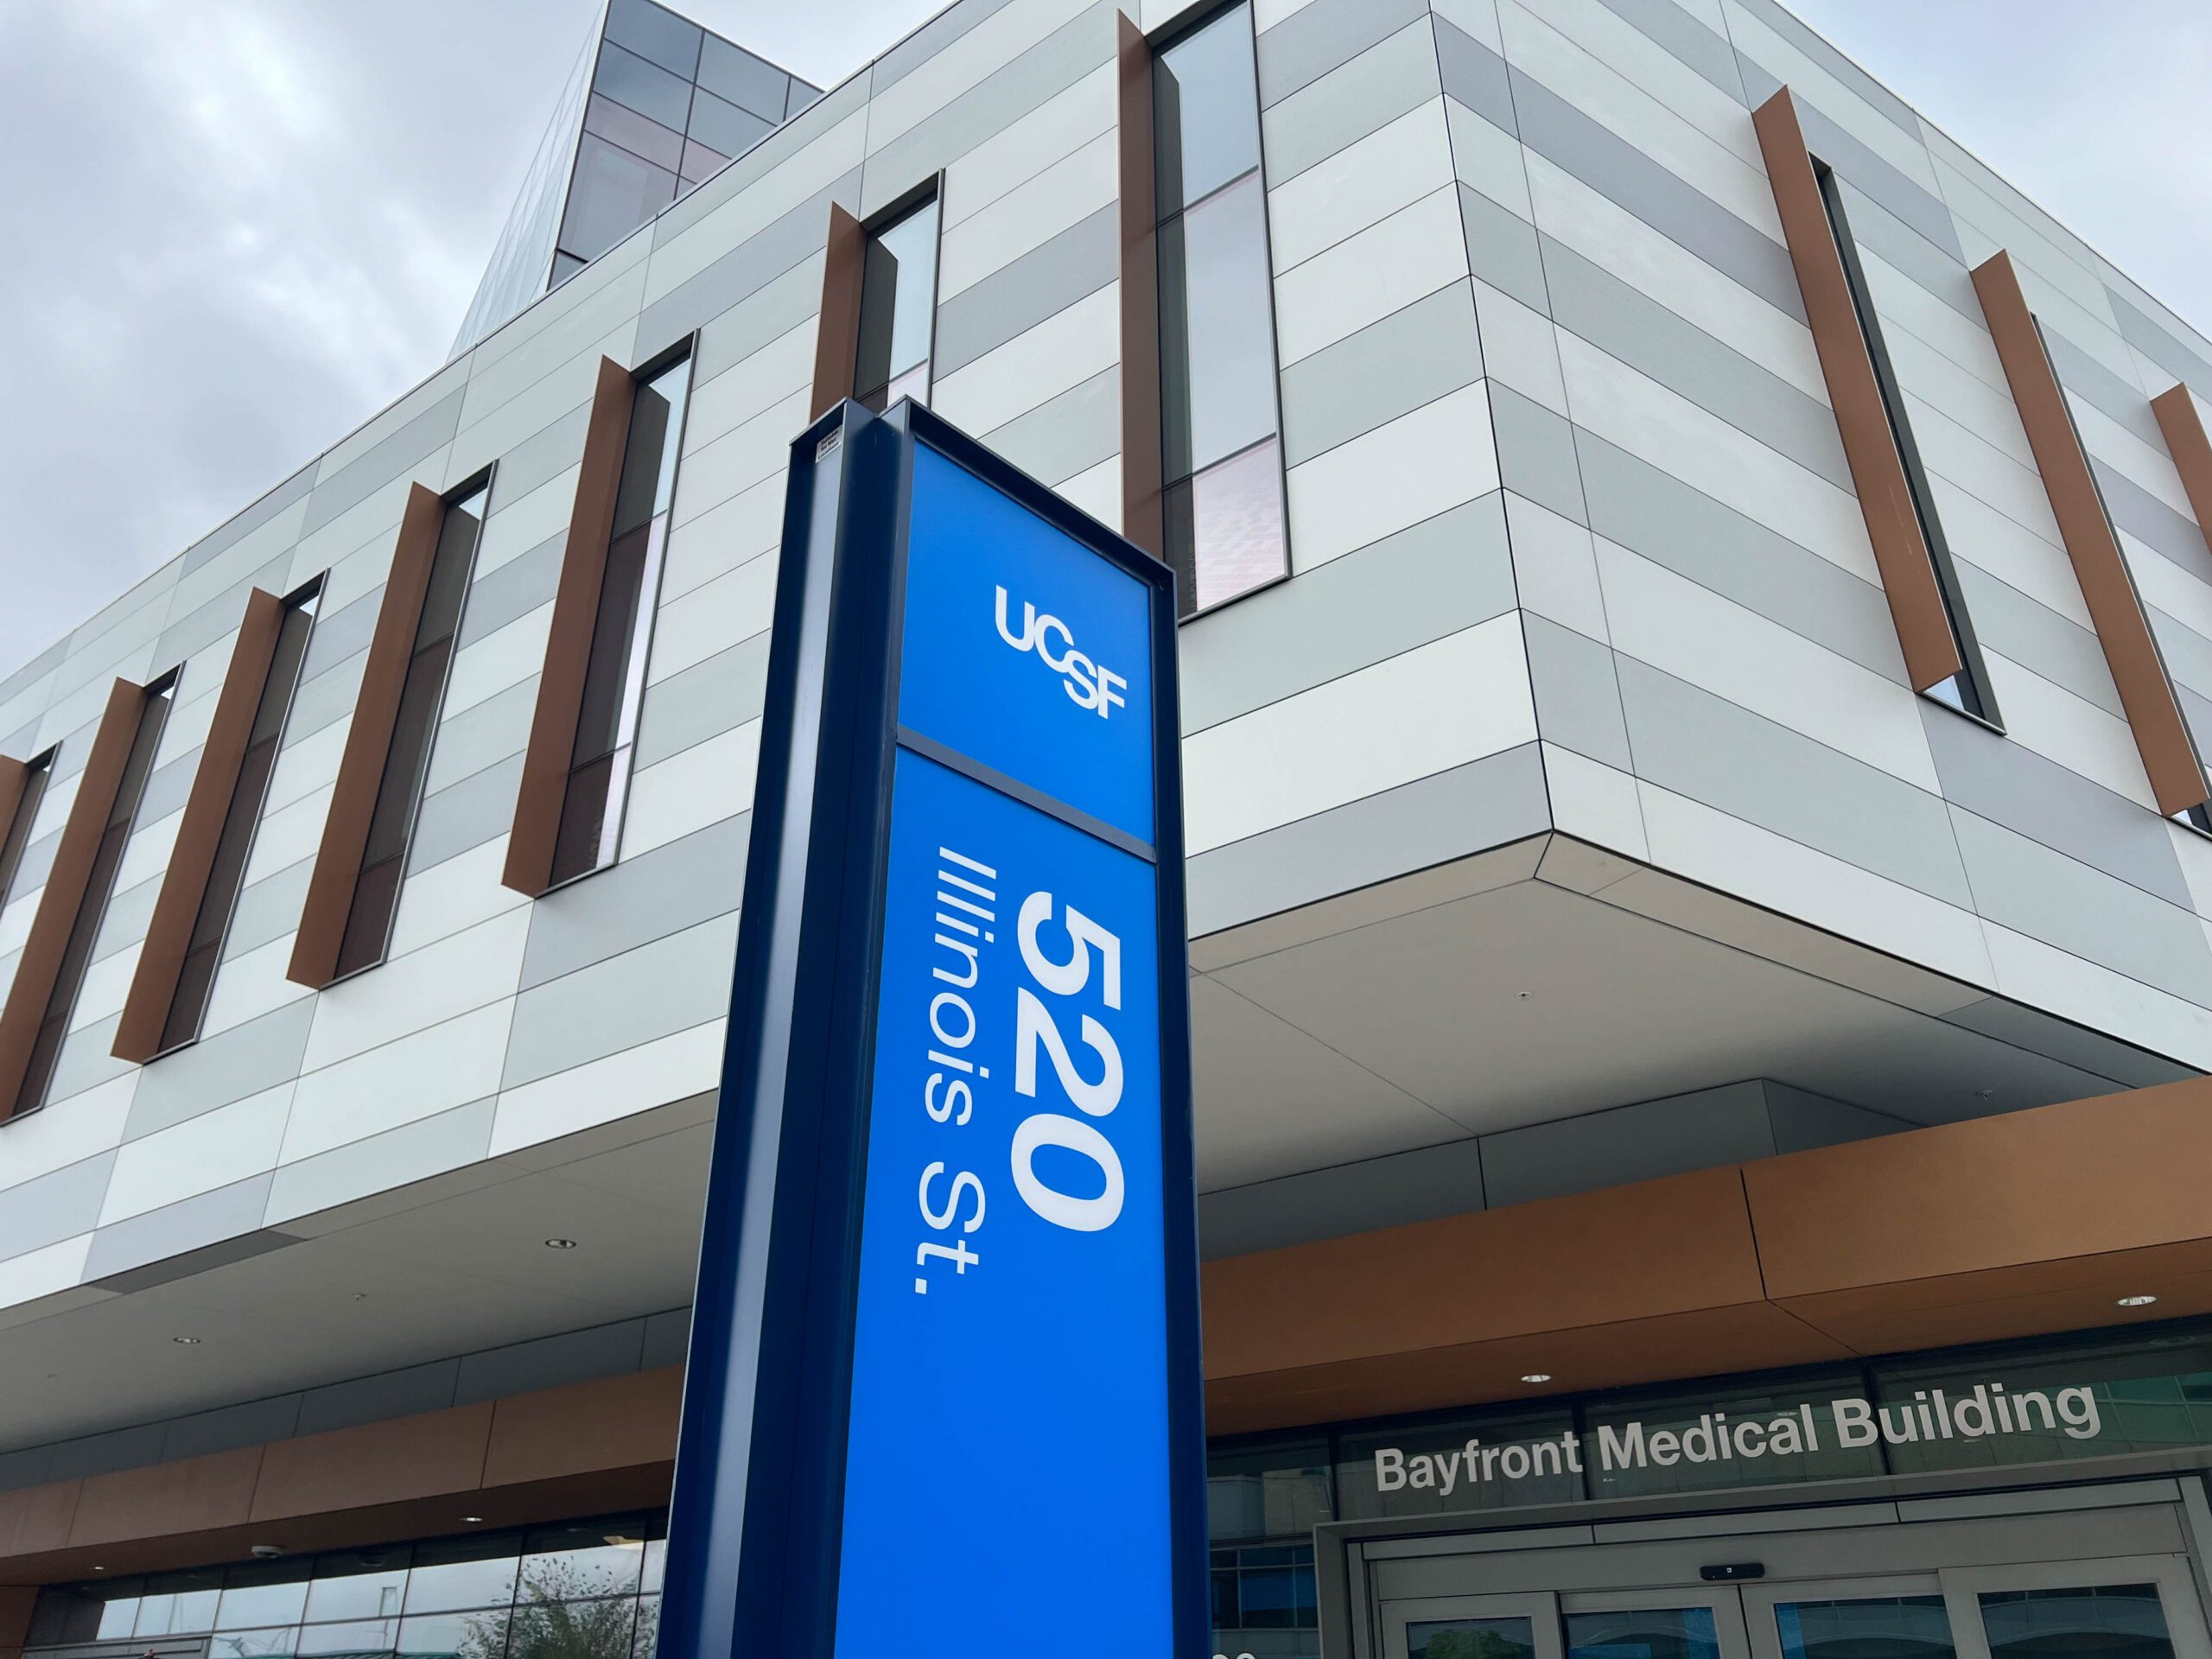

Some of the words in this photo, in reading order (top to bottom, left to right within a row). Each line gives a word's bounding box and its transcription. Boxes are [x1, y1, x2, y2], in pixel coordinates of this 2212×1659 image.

[995, 585, 1127, 720] UCSF
[925, 847, 997, 1126] Illinois
[1011, 891, 1124, 1232] 520
[915, 1161, 986, 1294] St.
[1375, 1431, 1583, 1496] Bayfront
[1598, 1403, 1819, 1471] Medical
[1831, 1382, 2101, 1448] Building
